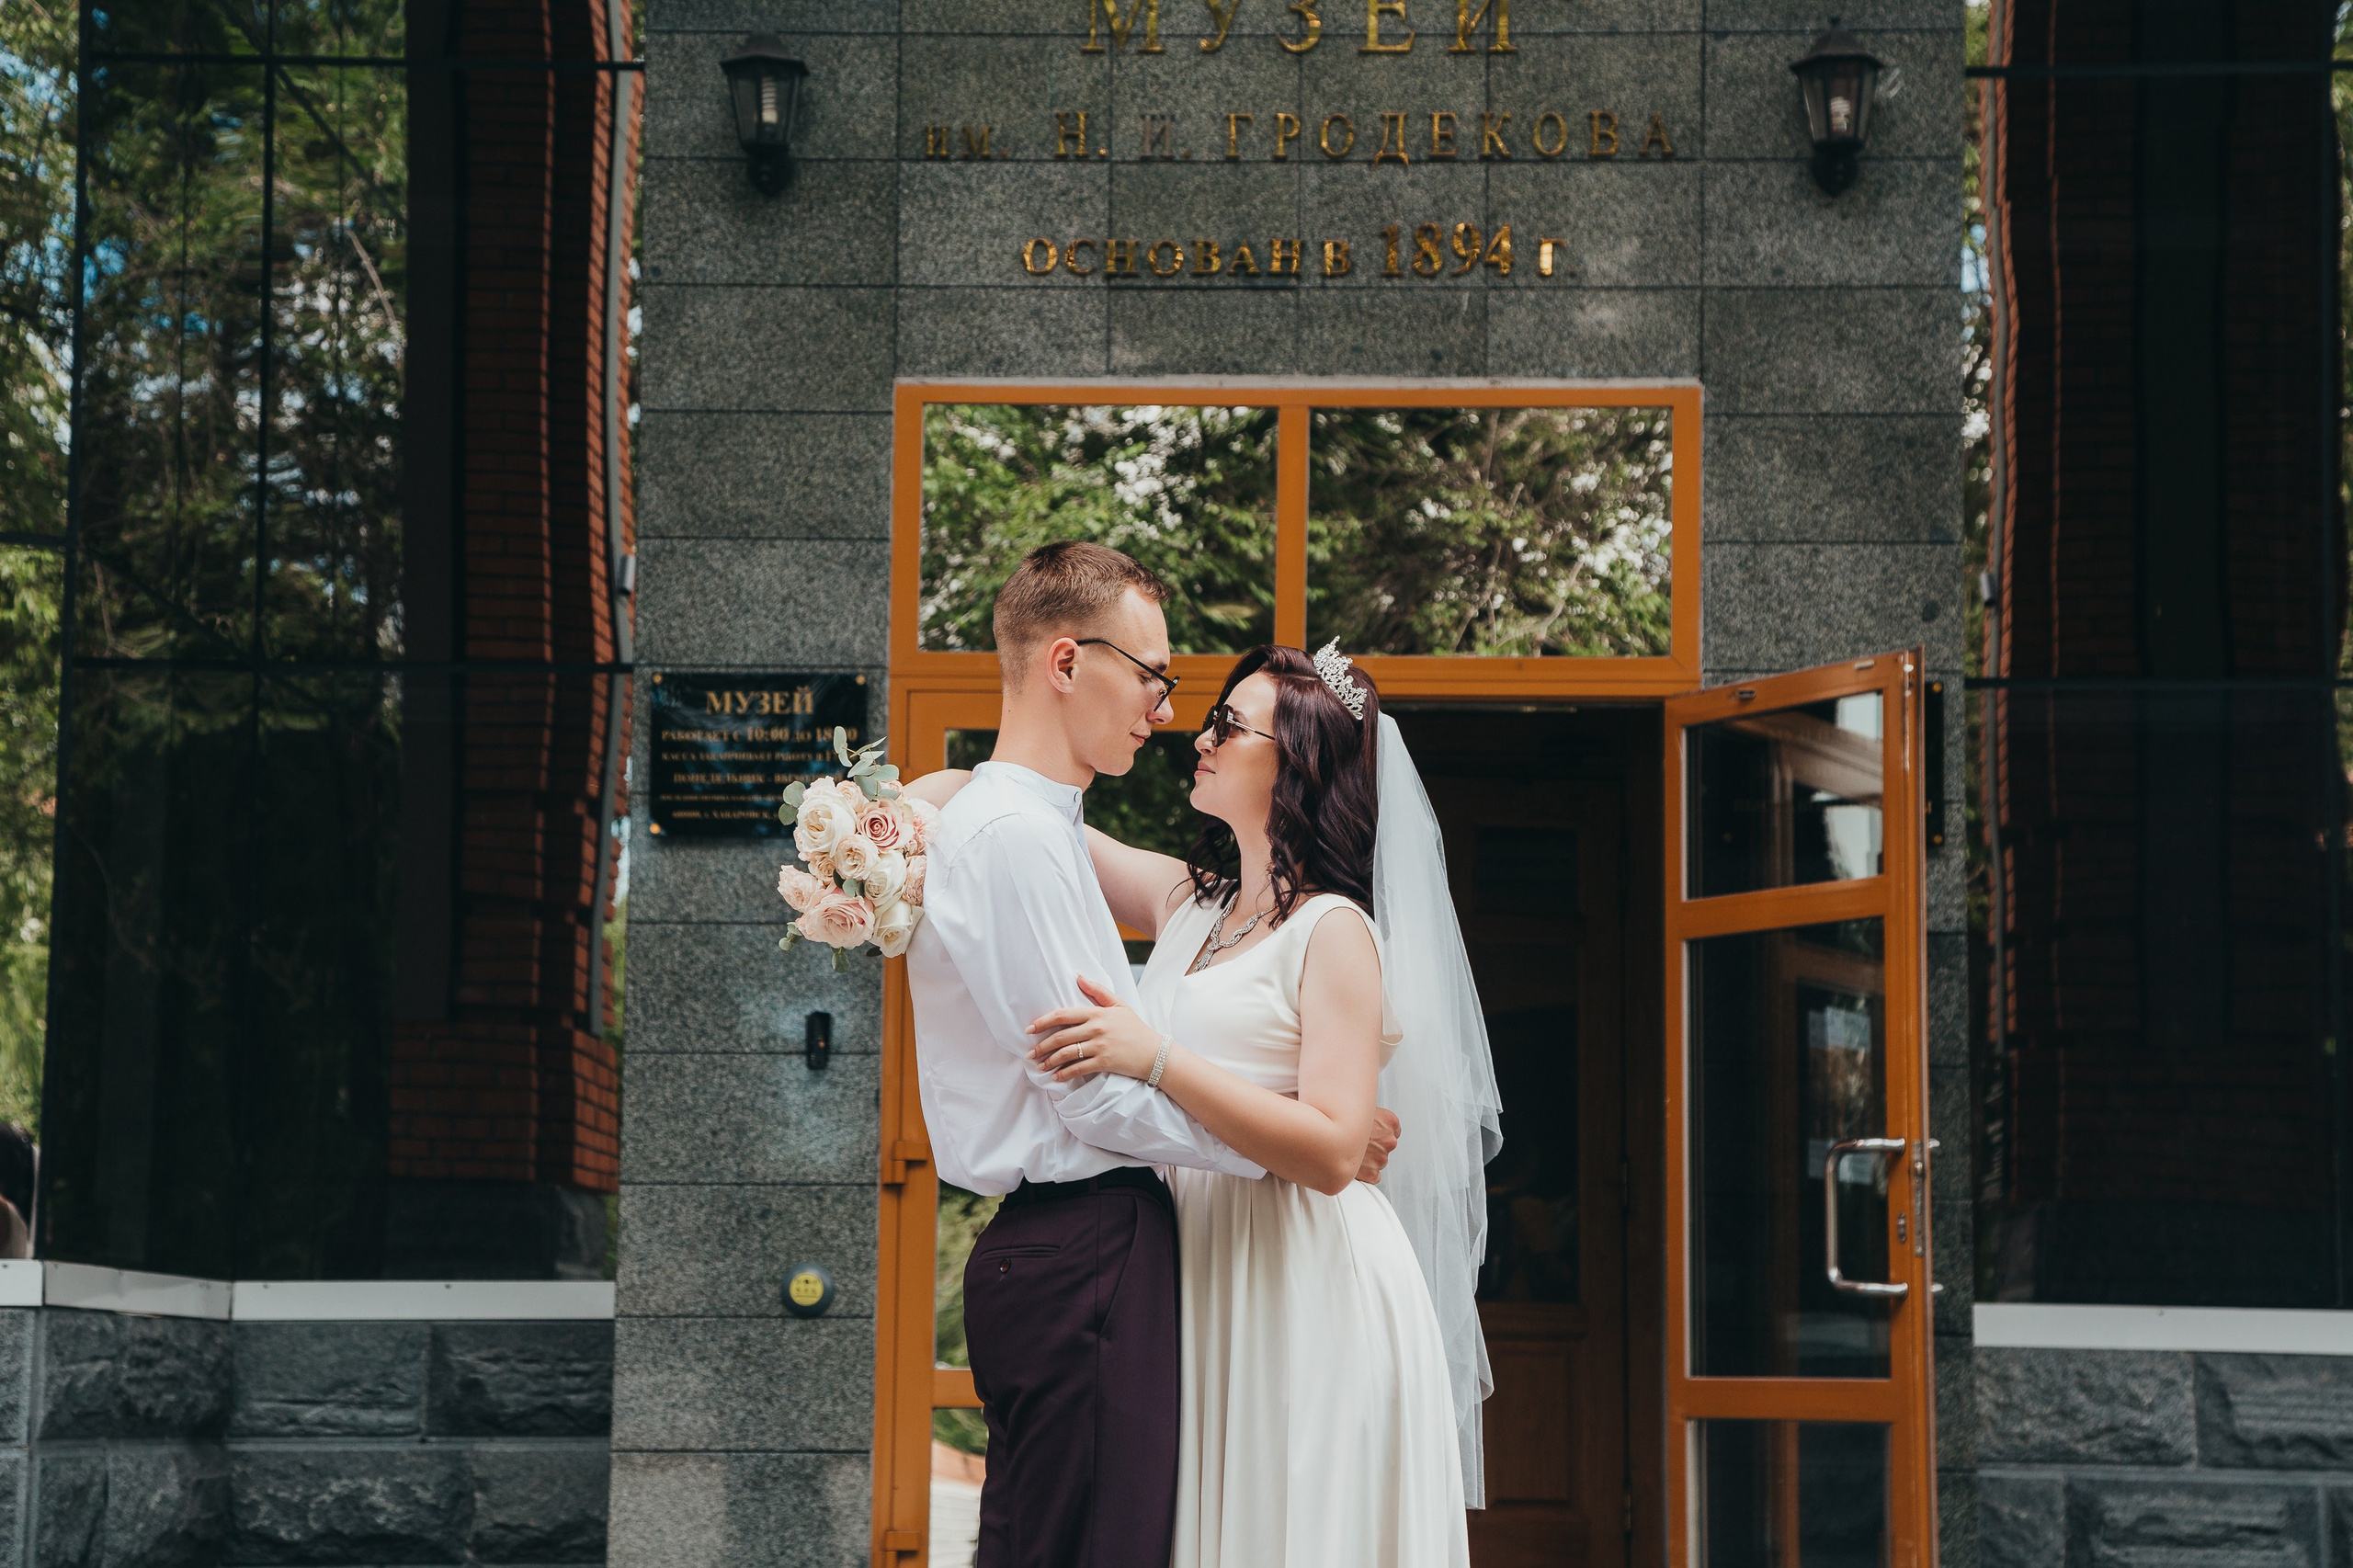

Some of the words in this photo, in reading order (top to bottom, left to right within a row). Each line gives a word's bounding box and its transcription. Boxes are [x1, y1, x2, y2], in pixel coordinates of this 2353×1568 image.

[1224, 110, 1676, 166] ГРОДЕКОВА
[1380, 222, 1515, 278] 1894
[706, 686, 814, 715] МУЗЕЙ
[746, 727, 790, 743] 10:00
[815, 727, 858, 743] 180
